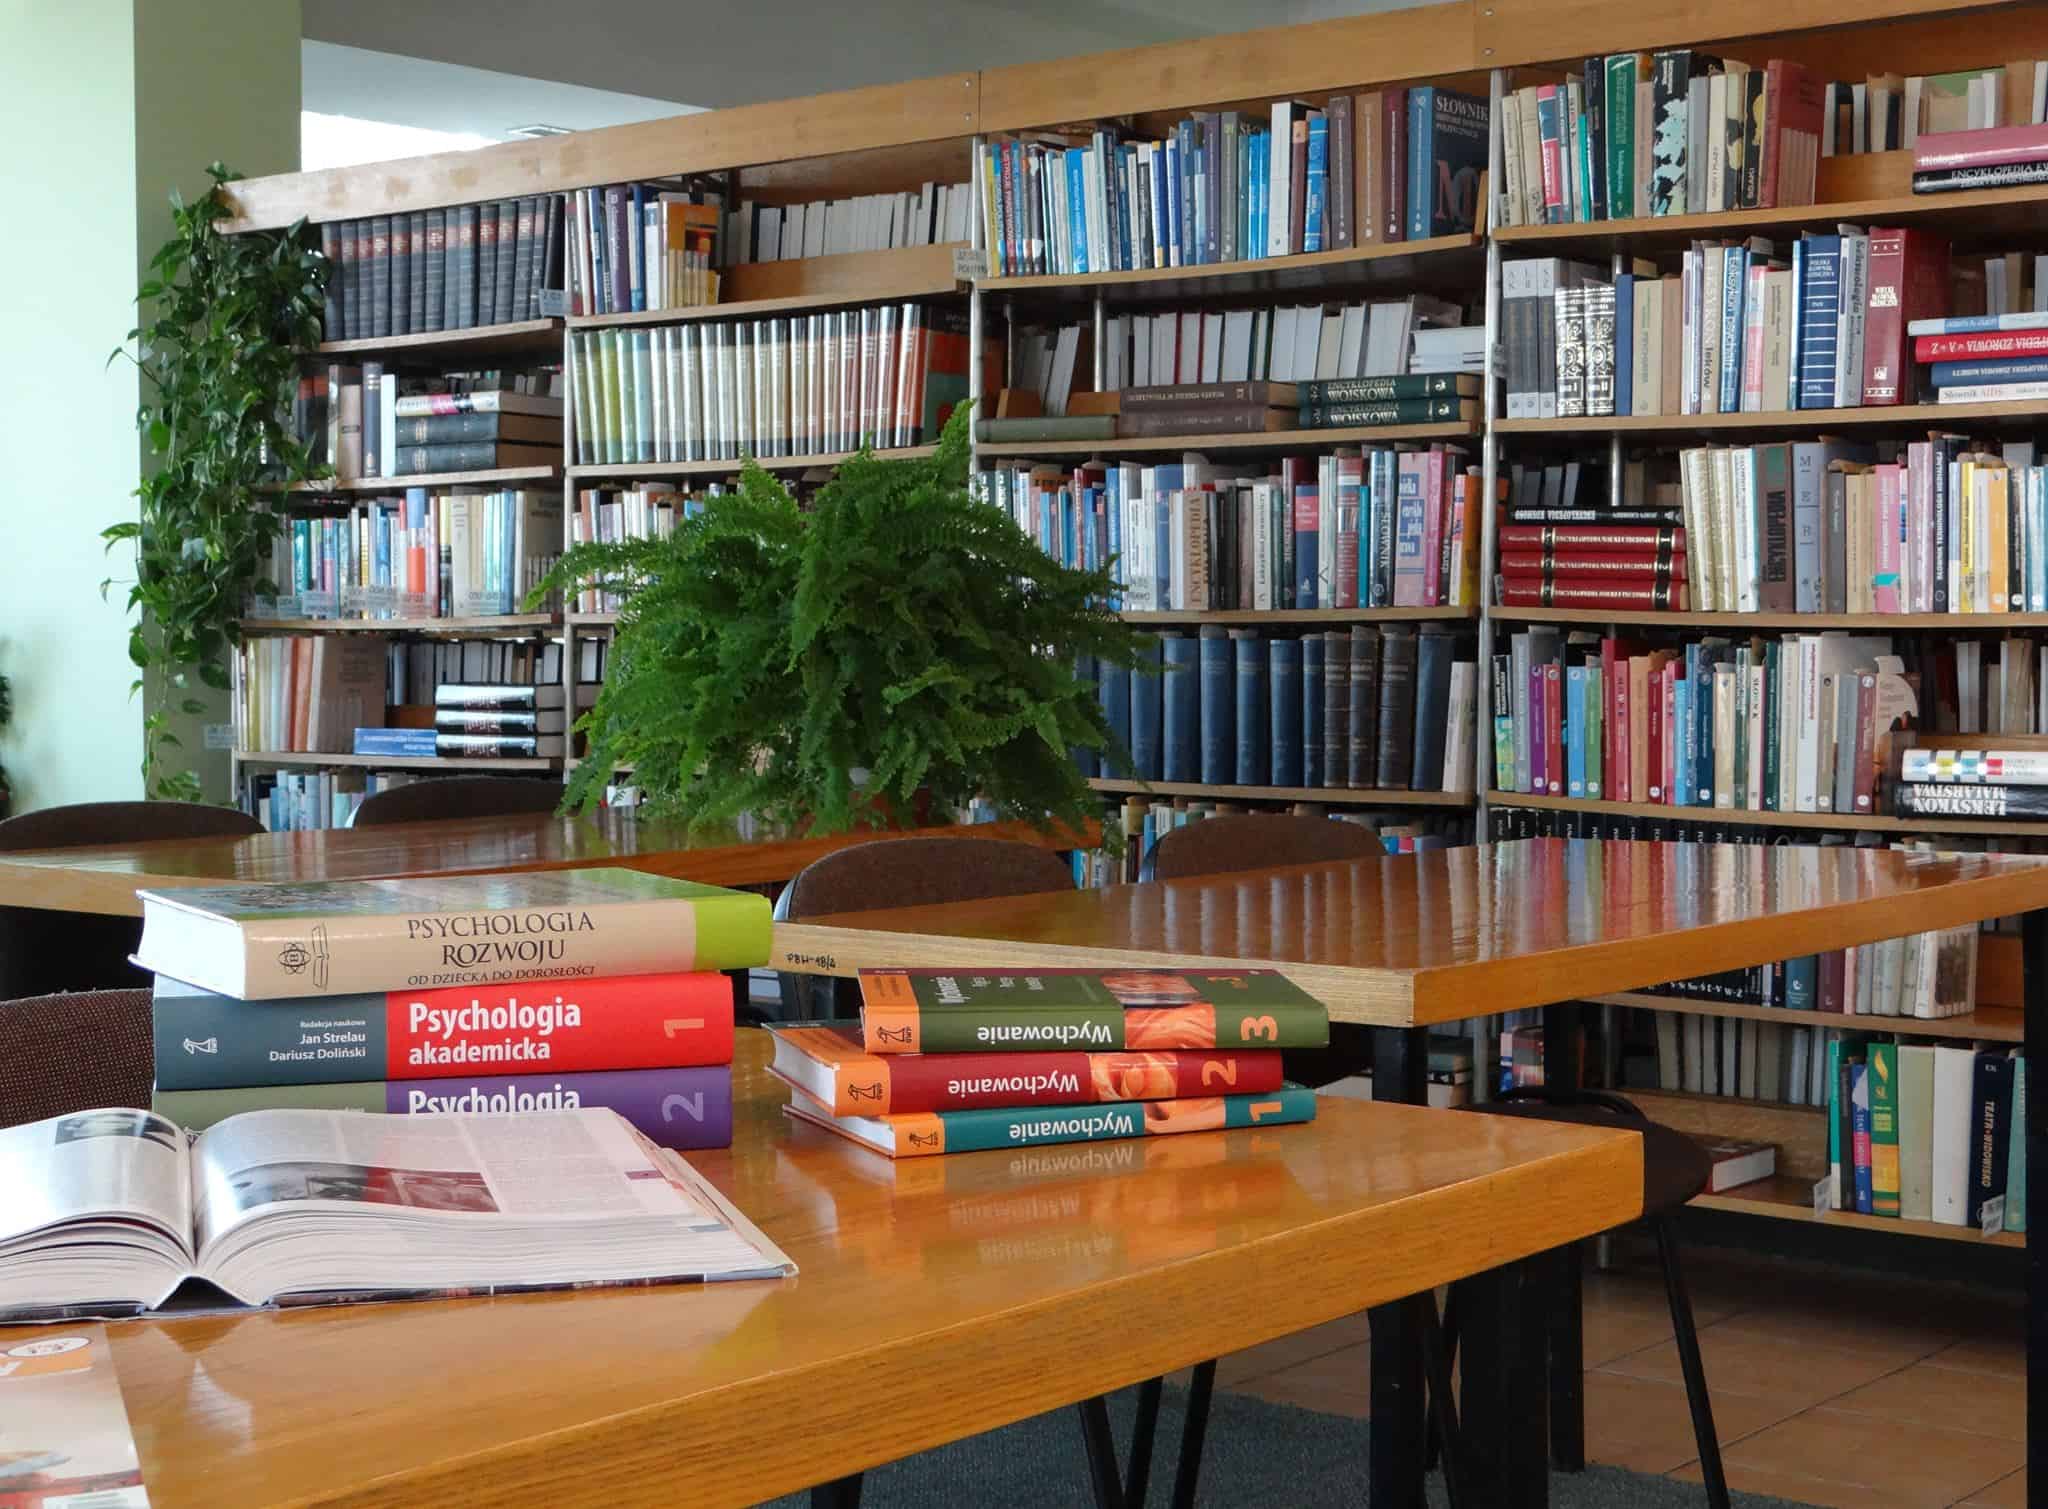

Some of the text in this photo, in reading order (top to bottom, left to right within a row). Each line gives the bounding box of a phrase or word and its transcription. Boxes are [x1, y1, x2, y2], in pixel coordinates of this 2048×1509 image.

[1436, 96, 1489, 120] SŁOWNIK
[1189, 496, 1202, 603] ENCYKLOPEDIA
[1380, 511, 1391, 568] SŁOWNIK
[1912, 784, 2007, 801] MALARSTWA
[1912, 799, 2007, 816] LEKSYKON
[407, 911, 596, 939] PSYCHOLOGIA
[441, 938, 565, 968] ROZWOJU
[407, 964, 596, 986] OD DZIECKA DO DOROSŁOŚCI
[409, 997, 582, 1040] Psychologia
[663, 1018, 705, 1039] 1
[1240, 1014, 1279, 1042] 3
[299, 1031, 366, 1045] Jan Strelau
[976, 1019, 1113, 1044] Wychowanie
[269, 1047, 367, 1062] Dariusz Doliński
[408, 1037, 551, 1065] akademicka
[947, 1072, 1080, 1097] Wychowanie
[1202, 1058, 1237, 1086] 2
[661, 1092, 704, 1123] 2
[1249, 1101, 1283, 1122] 1
[1008, 1113, 1134, 1139] Wychowanie
